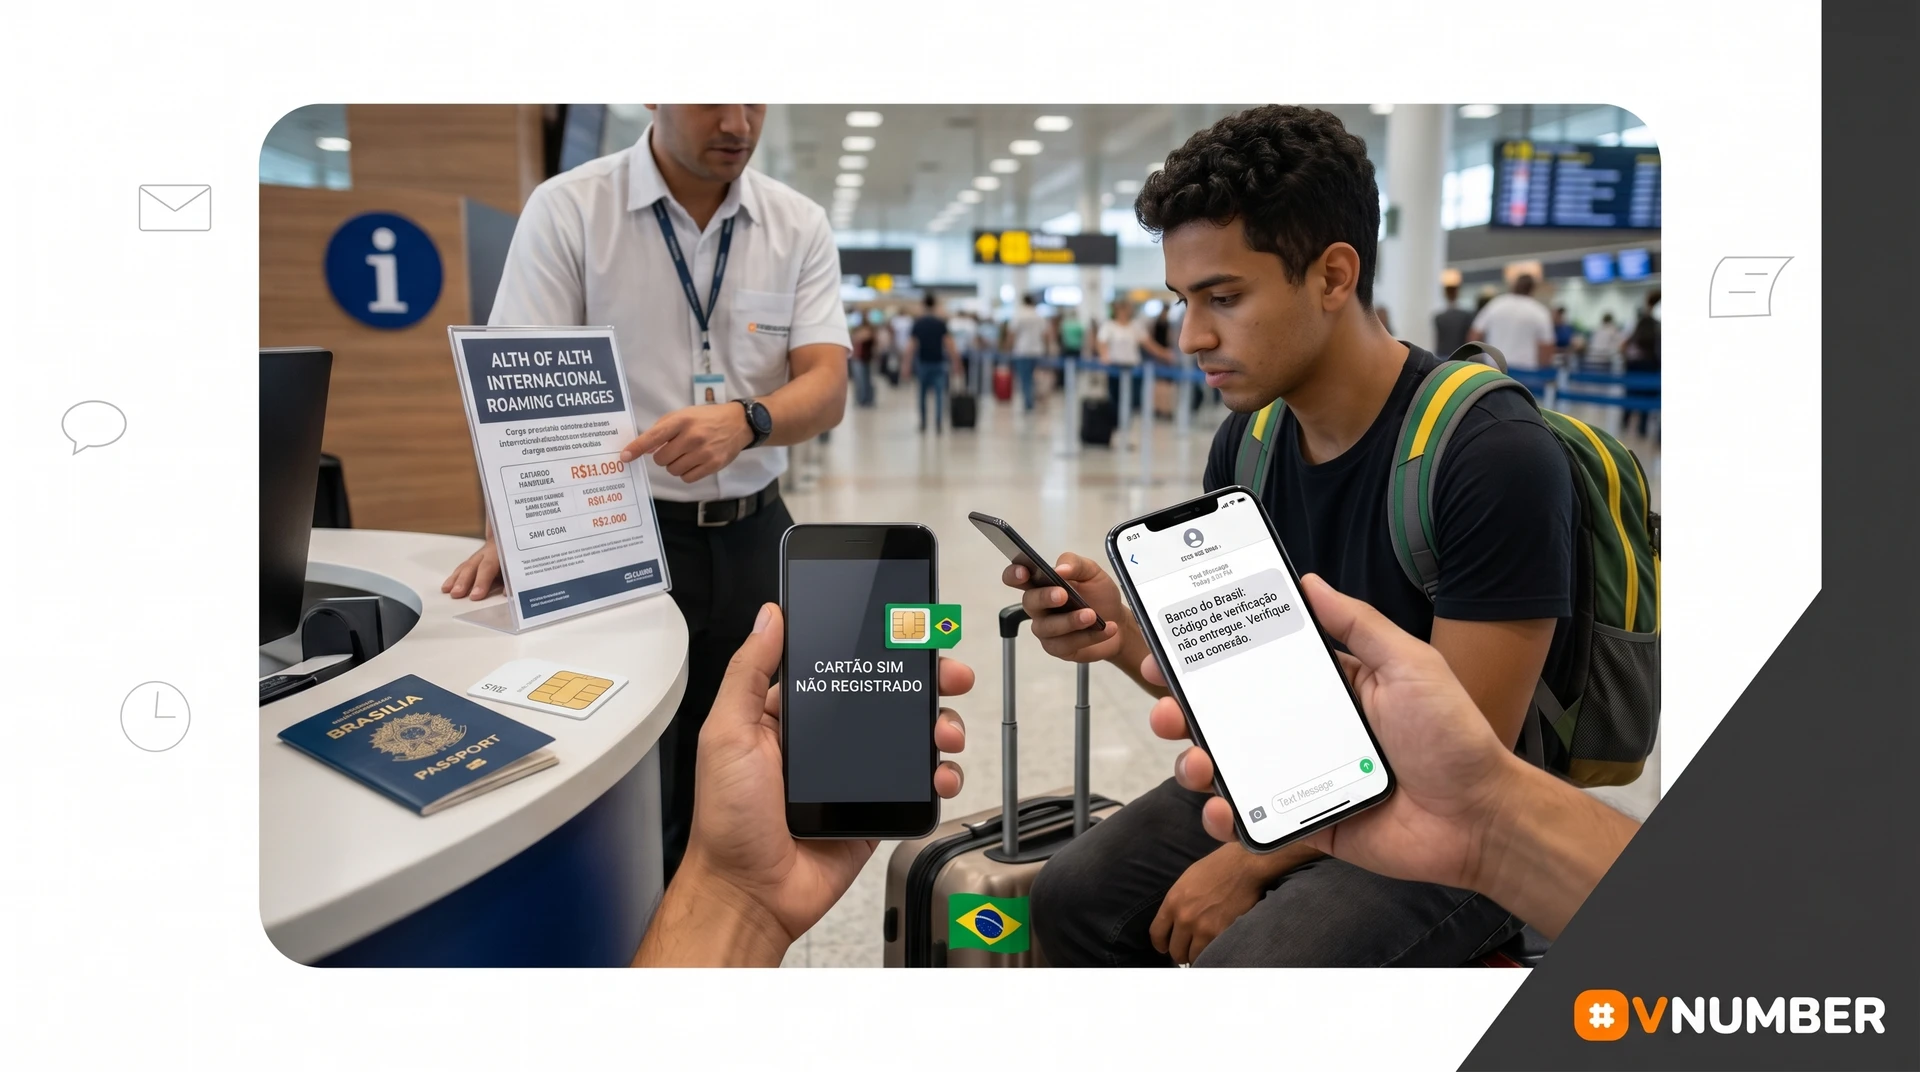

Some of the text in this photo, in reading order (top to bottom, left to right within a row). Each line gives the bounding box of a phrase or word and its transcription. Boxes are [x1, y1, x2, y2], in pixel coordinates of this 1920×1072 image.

[491, 349, 593, 368] ALTH OF ALTH
[486, 370, 607, 391] INTERNACIONAL
[486, 390, 615, 413] ROAMING CHARGES
[592, 512, 627, 528] R$2.000
[1165, 587, 1246, 624] Banco do Brasil:
[1171, 592, 1277, 637] Código de verificação
[1177, 602, 1291, 651] não entregue. Verifique
[814, 659, 904, 673] CARTÃO SIM
[1184, 651, 1204, 665] nua
[796, 677, 923, 692] NÃO REGISTRADO
[326, 695, 423, 739] BRASILIA
[414, 734, 500, 780] PASSPORT
[1277, 779, 1334, 808] Text Message
